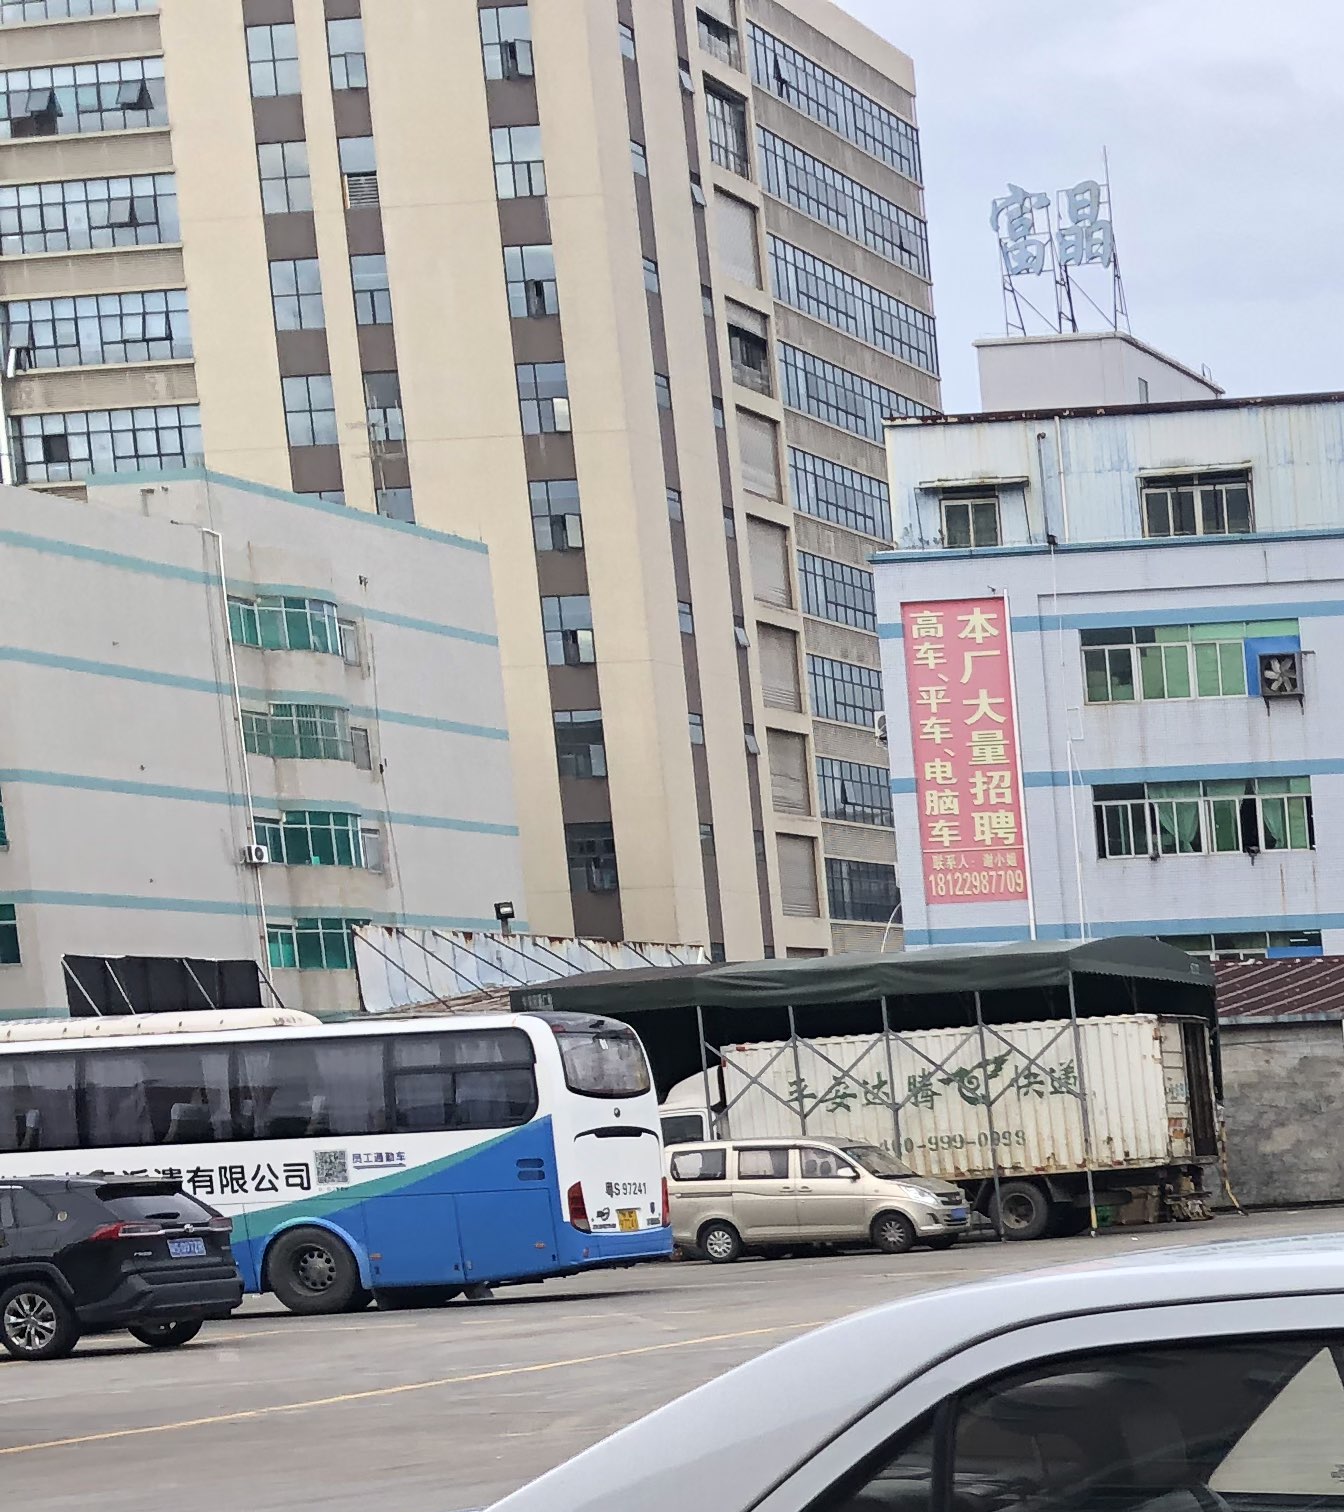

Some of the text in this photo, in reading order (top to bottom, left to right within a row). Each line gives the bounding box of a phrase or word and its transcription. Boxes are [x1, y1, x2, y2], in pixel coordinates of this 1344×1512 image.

[909, 610, 962, 847] 高车、平车、电脑车
[956, 607, 1018, 846] 本厂大量招聘
[928, 869, 1025, 896] 18122987709
